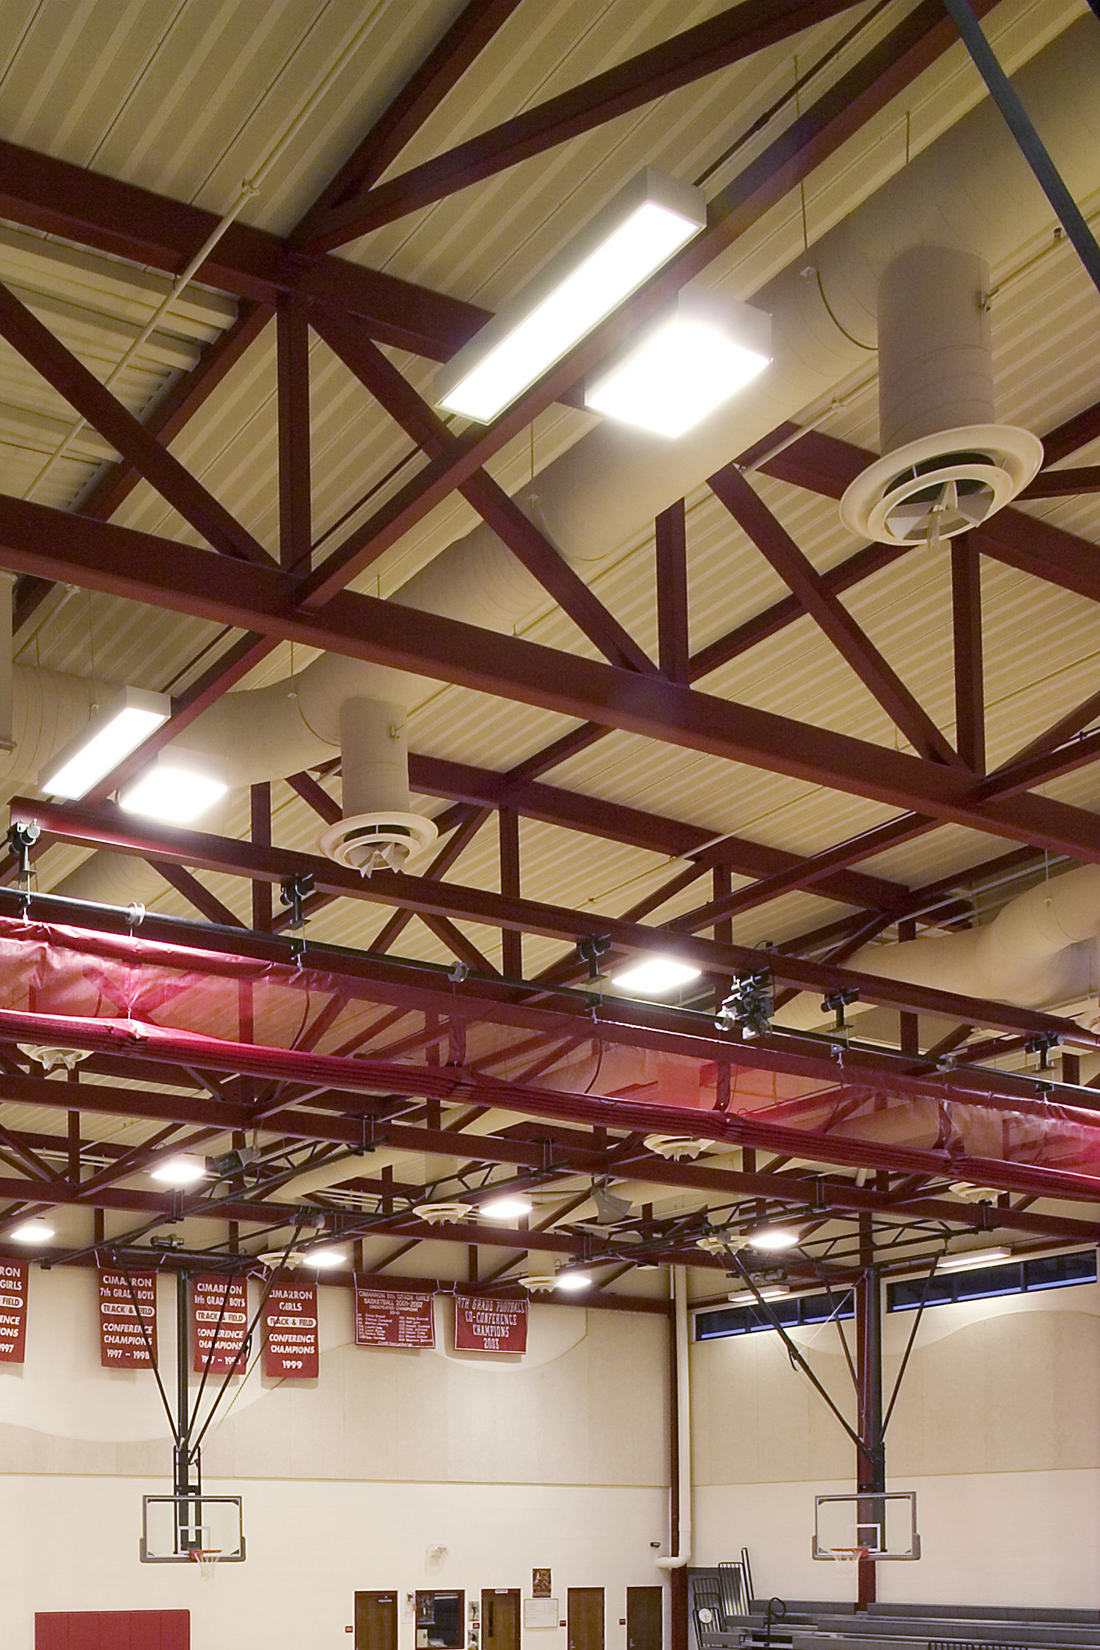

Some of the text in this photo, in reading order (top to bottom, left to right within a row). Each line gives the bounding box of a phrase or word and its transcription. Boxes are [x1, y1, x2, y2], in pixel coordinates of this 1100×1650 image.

[0, 1279, 22, 1291] GIRLS
[102, 1275, 152, 1287] CIMARON
[100, 1287, 111, 1297] 7th
[137, 1290, 154, 1300] BOYS
[2, 1297, 20, 1306] FIELD
[206, 1296, 225, 1306] GRAD
[229, 1297, 246, 1307] BOYS
[472, 1298, 494, 1311] GRADE
[103, 1304, 125, 1313] TRACK
[197, 1311, 219, 1320] TRACK
[228, 1313, 244, 1322] FIELD
[464, 1310, 517, 1326] CO-CONFERENCE
[472, 1324, 510, 1338] CHAMPIONS
[269, 1333, 315, 1343] CONFERENCE
[106, 1349, 123, 1358] 1997
[133, 1350, 150, 1360] 1998
[270, 1344, 315, 1354] CHAMPIONS
[282, 1360, 303, 1369] 1999
